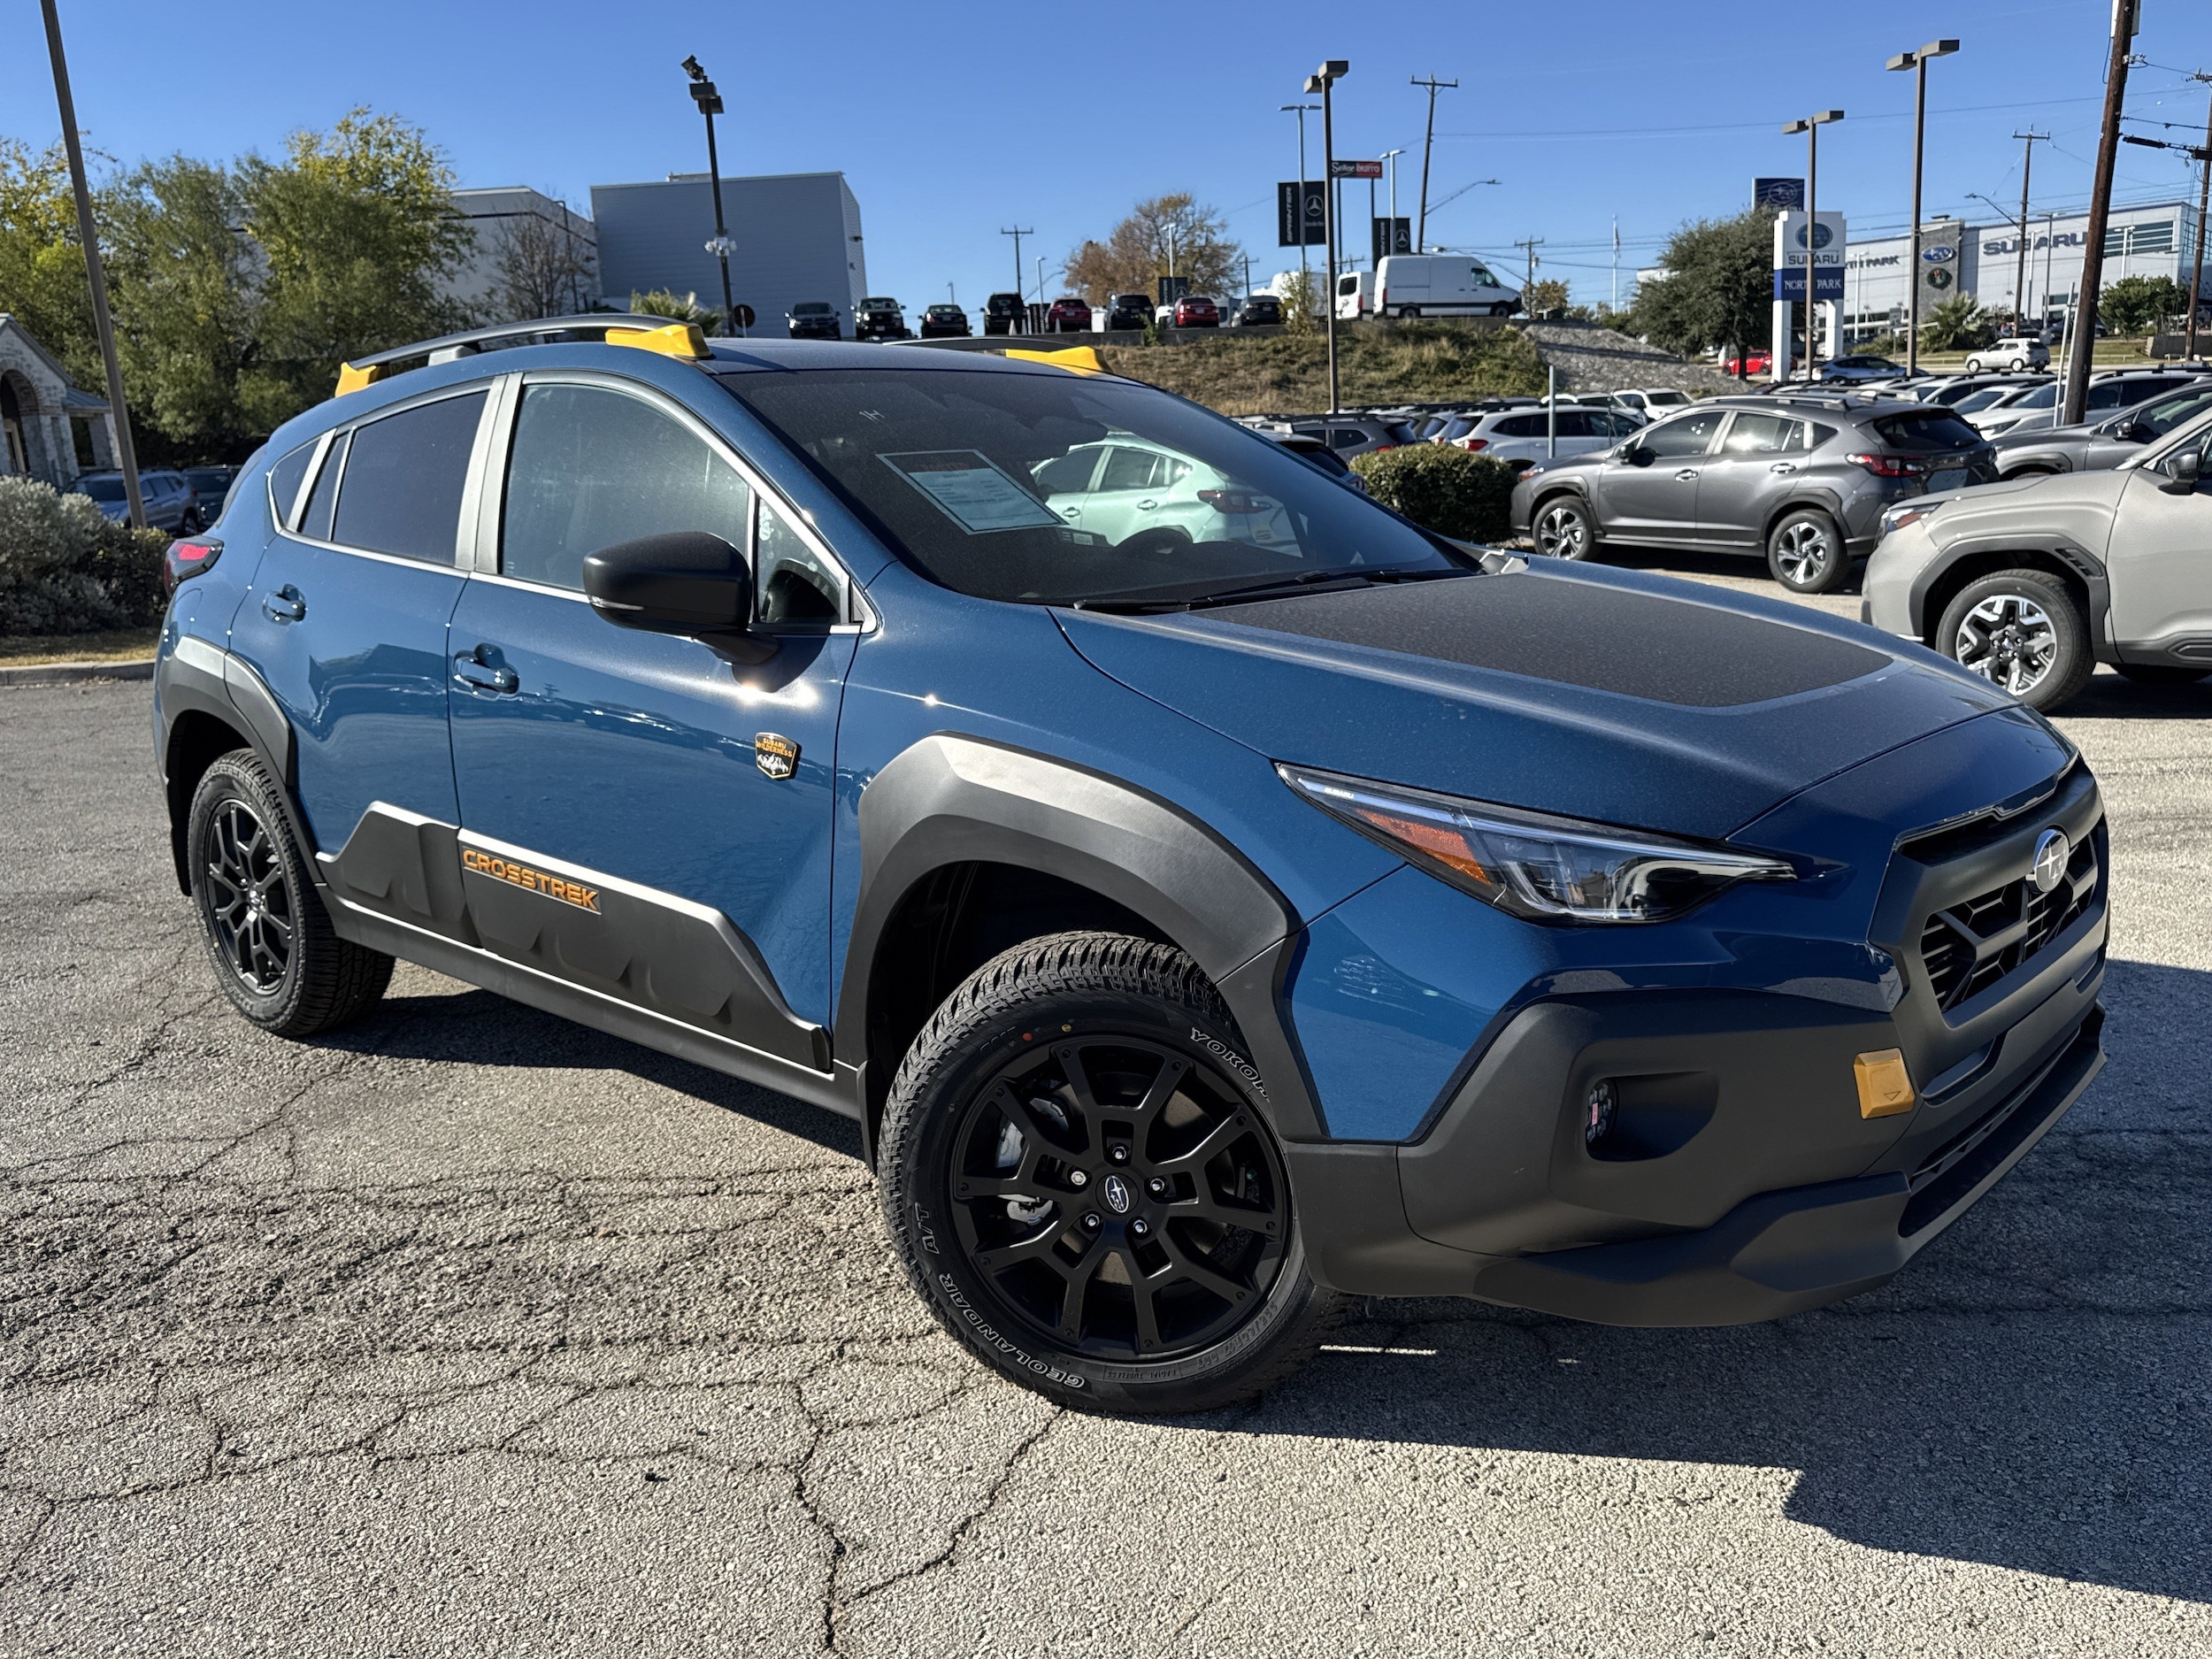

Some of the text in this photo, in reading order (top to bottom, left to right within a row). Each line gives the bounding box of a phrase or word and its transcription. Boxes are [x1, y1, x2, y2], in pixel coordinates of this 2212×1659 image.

[1788, 255, 1839, 265] SUARU
[1866, 256, 1900, 267] PARK
[1816, 279, 1841, 289] PARK
[756, 741, 793, 758] WILDERNESS
[763, 738, 787, 749] SUBARU
[1324, 787, 1355, 800] SUBARU
[463, 849, 598, 910] CROSSTREK
[1190, 1026, 1271, 1103] YOKOH
[915, 1202, 1086, 1388] GEOLANDAR A/T
